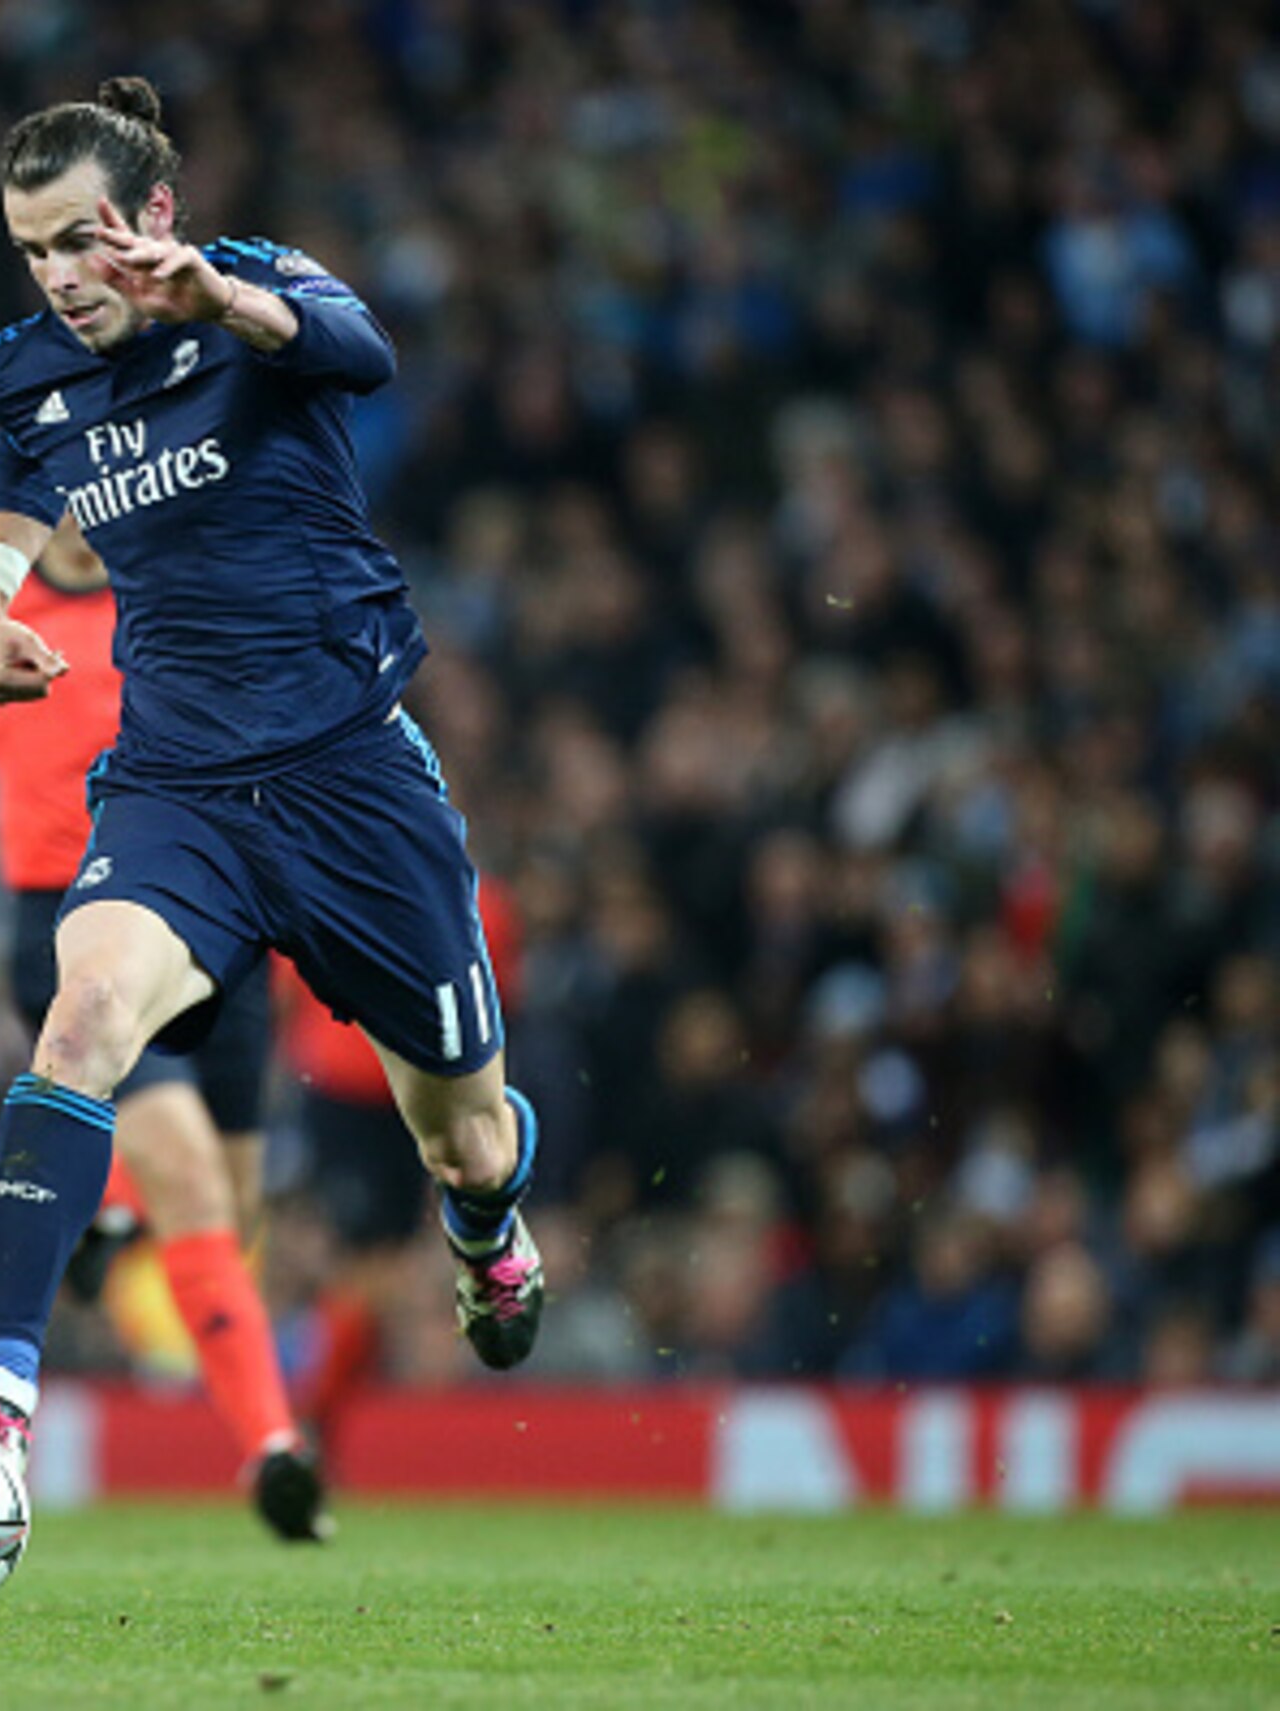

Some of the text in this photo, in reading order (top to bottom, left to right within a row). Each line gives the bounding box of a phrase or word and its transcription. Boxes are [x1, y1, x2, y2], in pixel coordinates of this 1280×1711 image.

[55, 437, 229, 530] mirates
[84, 418, 145, 464] Fly
[435, 961, 492, 1062] 11
